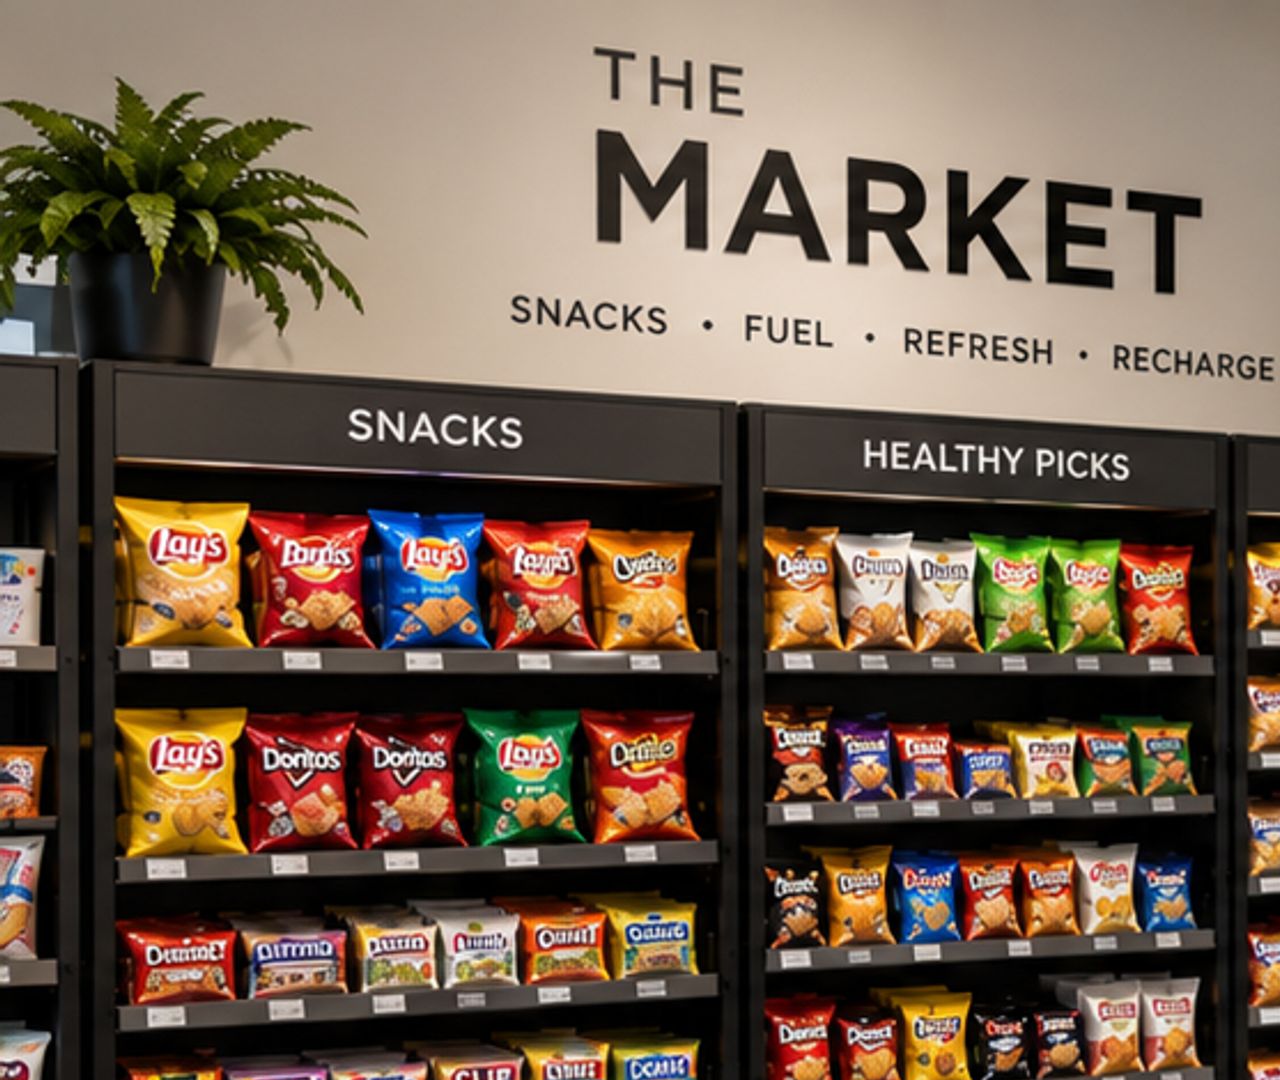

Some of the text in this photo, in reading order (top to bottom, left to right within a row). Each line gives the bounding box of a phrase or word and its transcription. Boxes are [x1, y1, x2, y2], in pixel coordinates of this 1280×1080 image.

[593, 46, 744, 117] THE
[596, 128, 1203, 295] MARKET
[510, 295, 1276, 383] SNACKS FUEL REFRESH RECHARGE
[347, 408, 524, 450] SNACKS
[863, 439, 1131, 482] HEALTHY PICKS
[156, 527, 223, 565] Lay's
[156, 735, 220, 772] Lay's
[262, 745, 342, 771] Doritos
